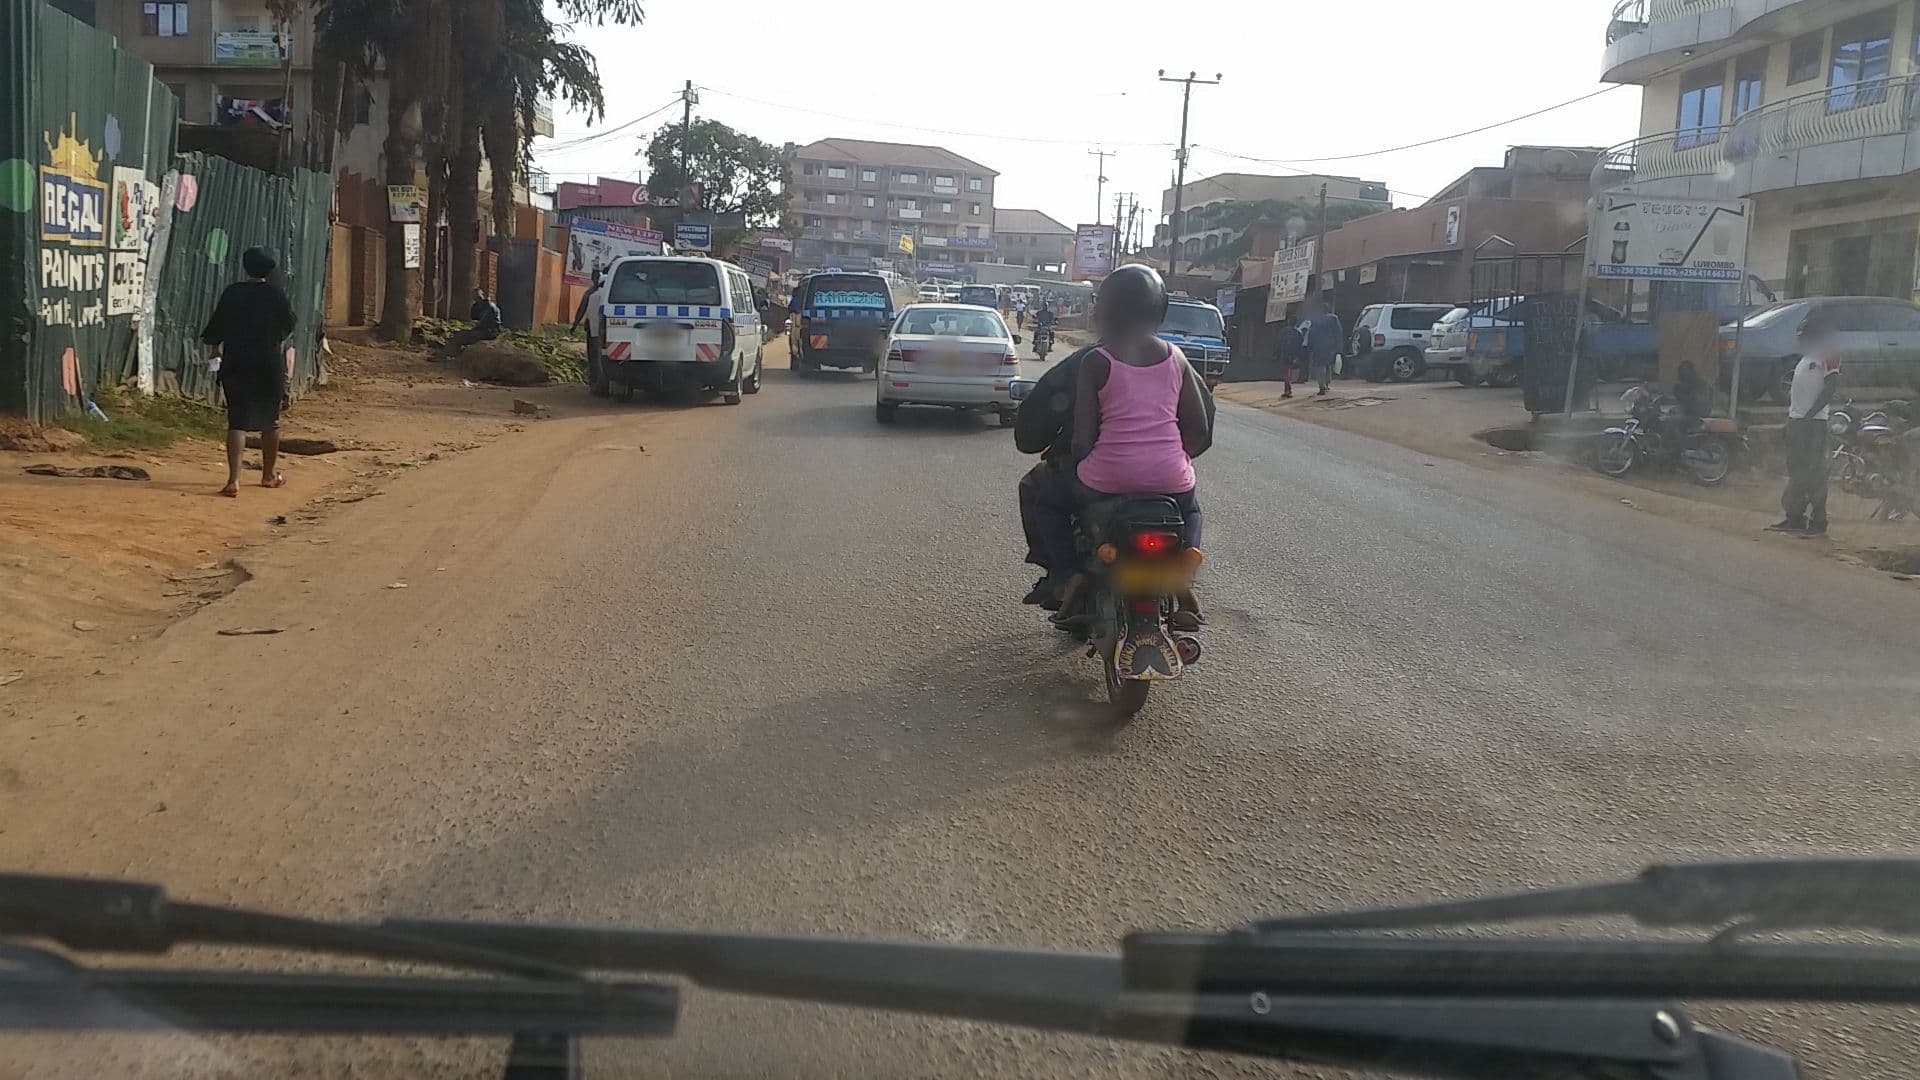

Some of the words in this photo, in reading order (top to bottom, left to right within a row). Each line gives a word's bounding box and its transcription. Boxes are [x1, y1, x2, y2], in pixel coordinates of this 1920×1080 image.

[45, 182, 102, 233] REGAL
[607, 224, 634, 235] NEW
[636, 230, 661, 240] LIFE
[677, 225, 707, 233] SPECTRUM
[677, 233, 707, 241] PHARMACY
[956, 238, 987, 246] CLINIC
[42, 249, 104, 291] PAINTS
